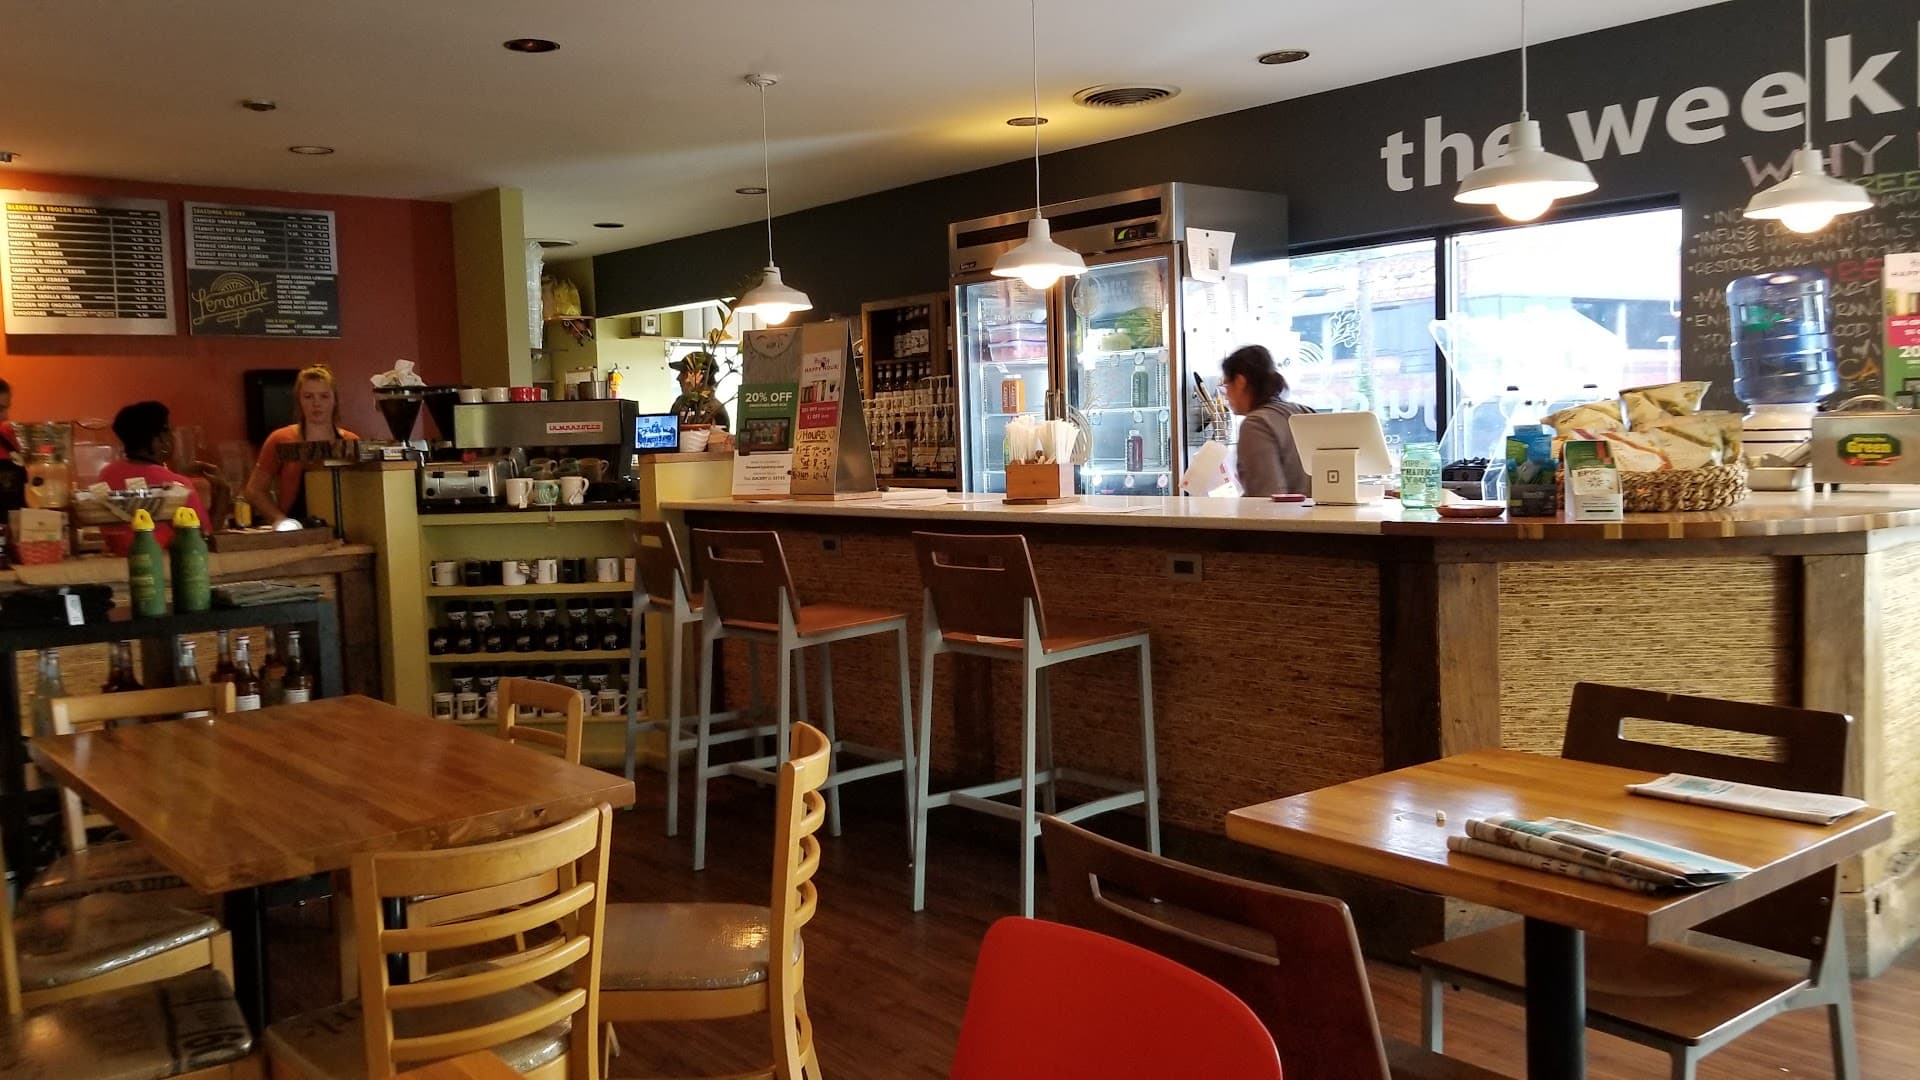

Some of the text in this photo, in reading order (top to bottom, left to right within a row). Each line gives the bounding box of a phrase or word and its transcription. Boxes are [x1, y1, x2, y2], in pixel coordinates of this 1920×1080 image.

[1567, 20, 1920, 162] week
[191, 281, 270, 325] Lemonade
[1898, 345, 1920, 358] 20
[745, 391, 793, 403] 20% OFF
[803, 431, 827, 440] HOURS
